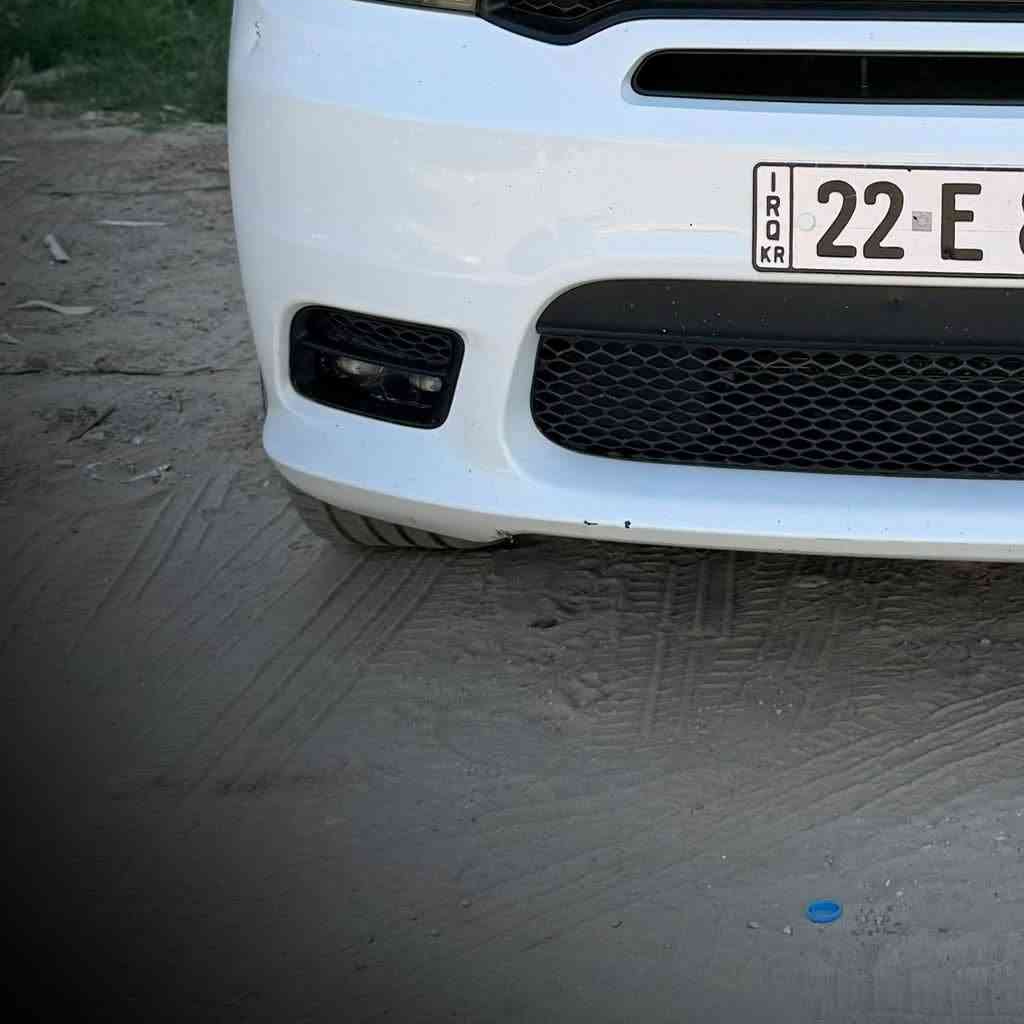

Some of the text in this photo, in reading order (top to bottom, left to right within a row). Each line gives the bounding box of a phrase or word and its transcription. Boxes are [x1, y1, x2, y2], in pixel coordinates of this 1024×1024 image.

[816, 180, 905, 260] 22
[940, 183, 983, 261] E
[760, 246, 785, 263] KR
